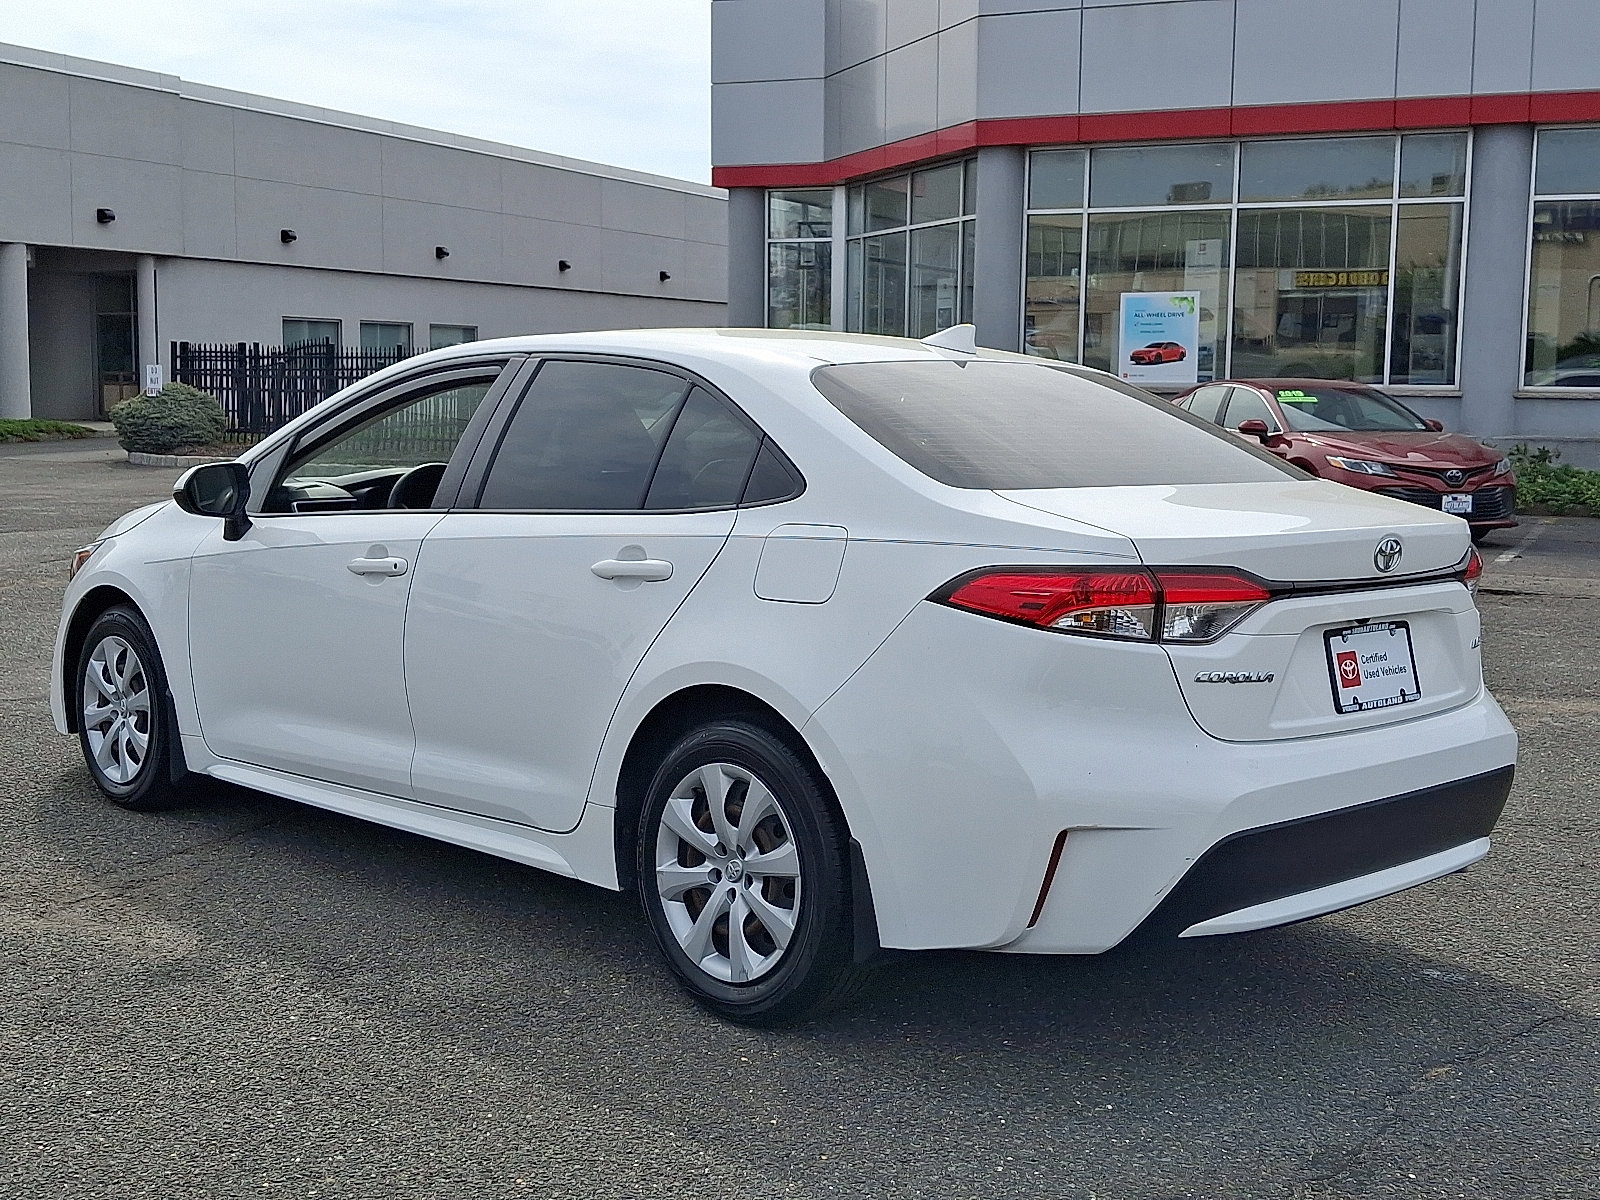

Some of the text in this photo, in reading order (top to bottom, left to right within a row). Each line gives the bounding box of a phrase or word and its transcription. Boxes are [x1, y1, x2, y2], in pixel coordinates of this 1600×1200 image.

[1360, 652, 1388, 665] Certified
[1194, 671, 1275, 684] COROLLA
[1363, 664, 1407, 680] Used Vehicles
[1361, 695, 1403, 710] AUTOLAND
